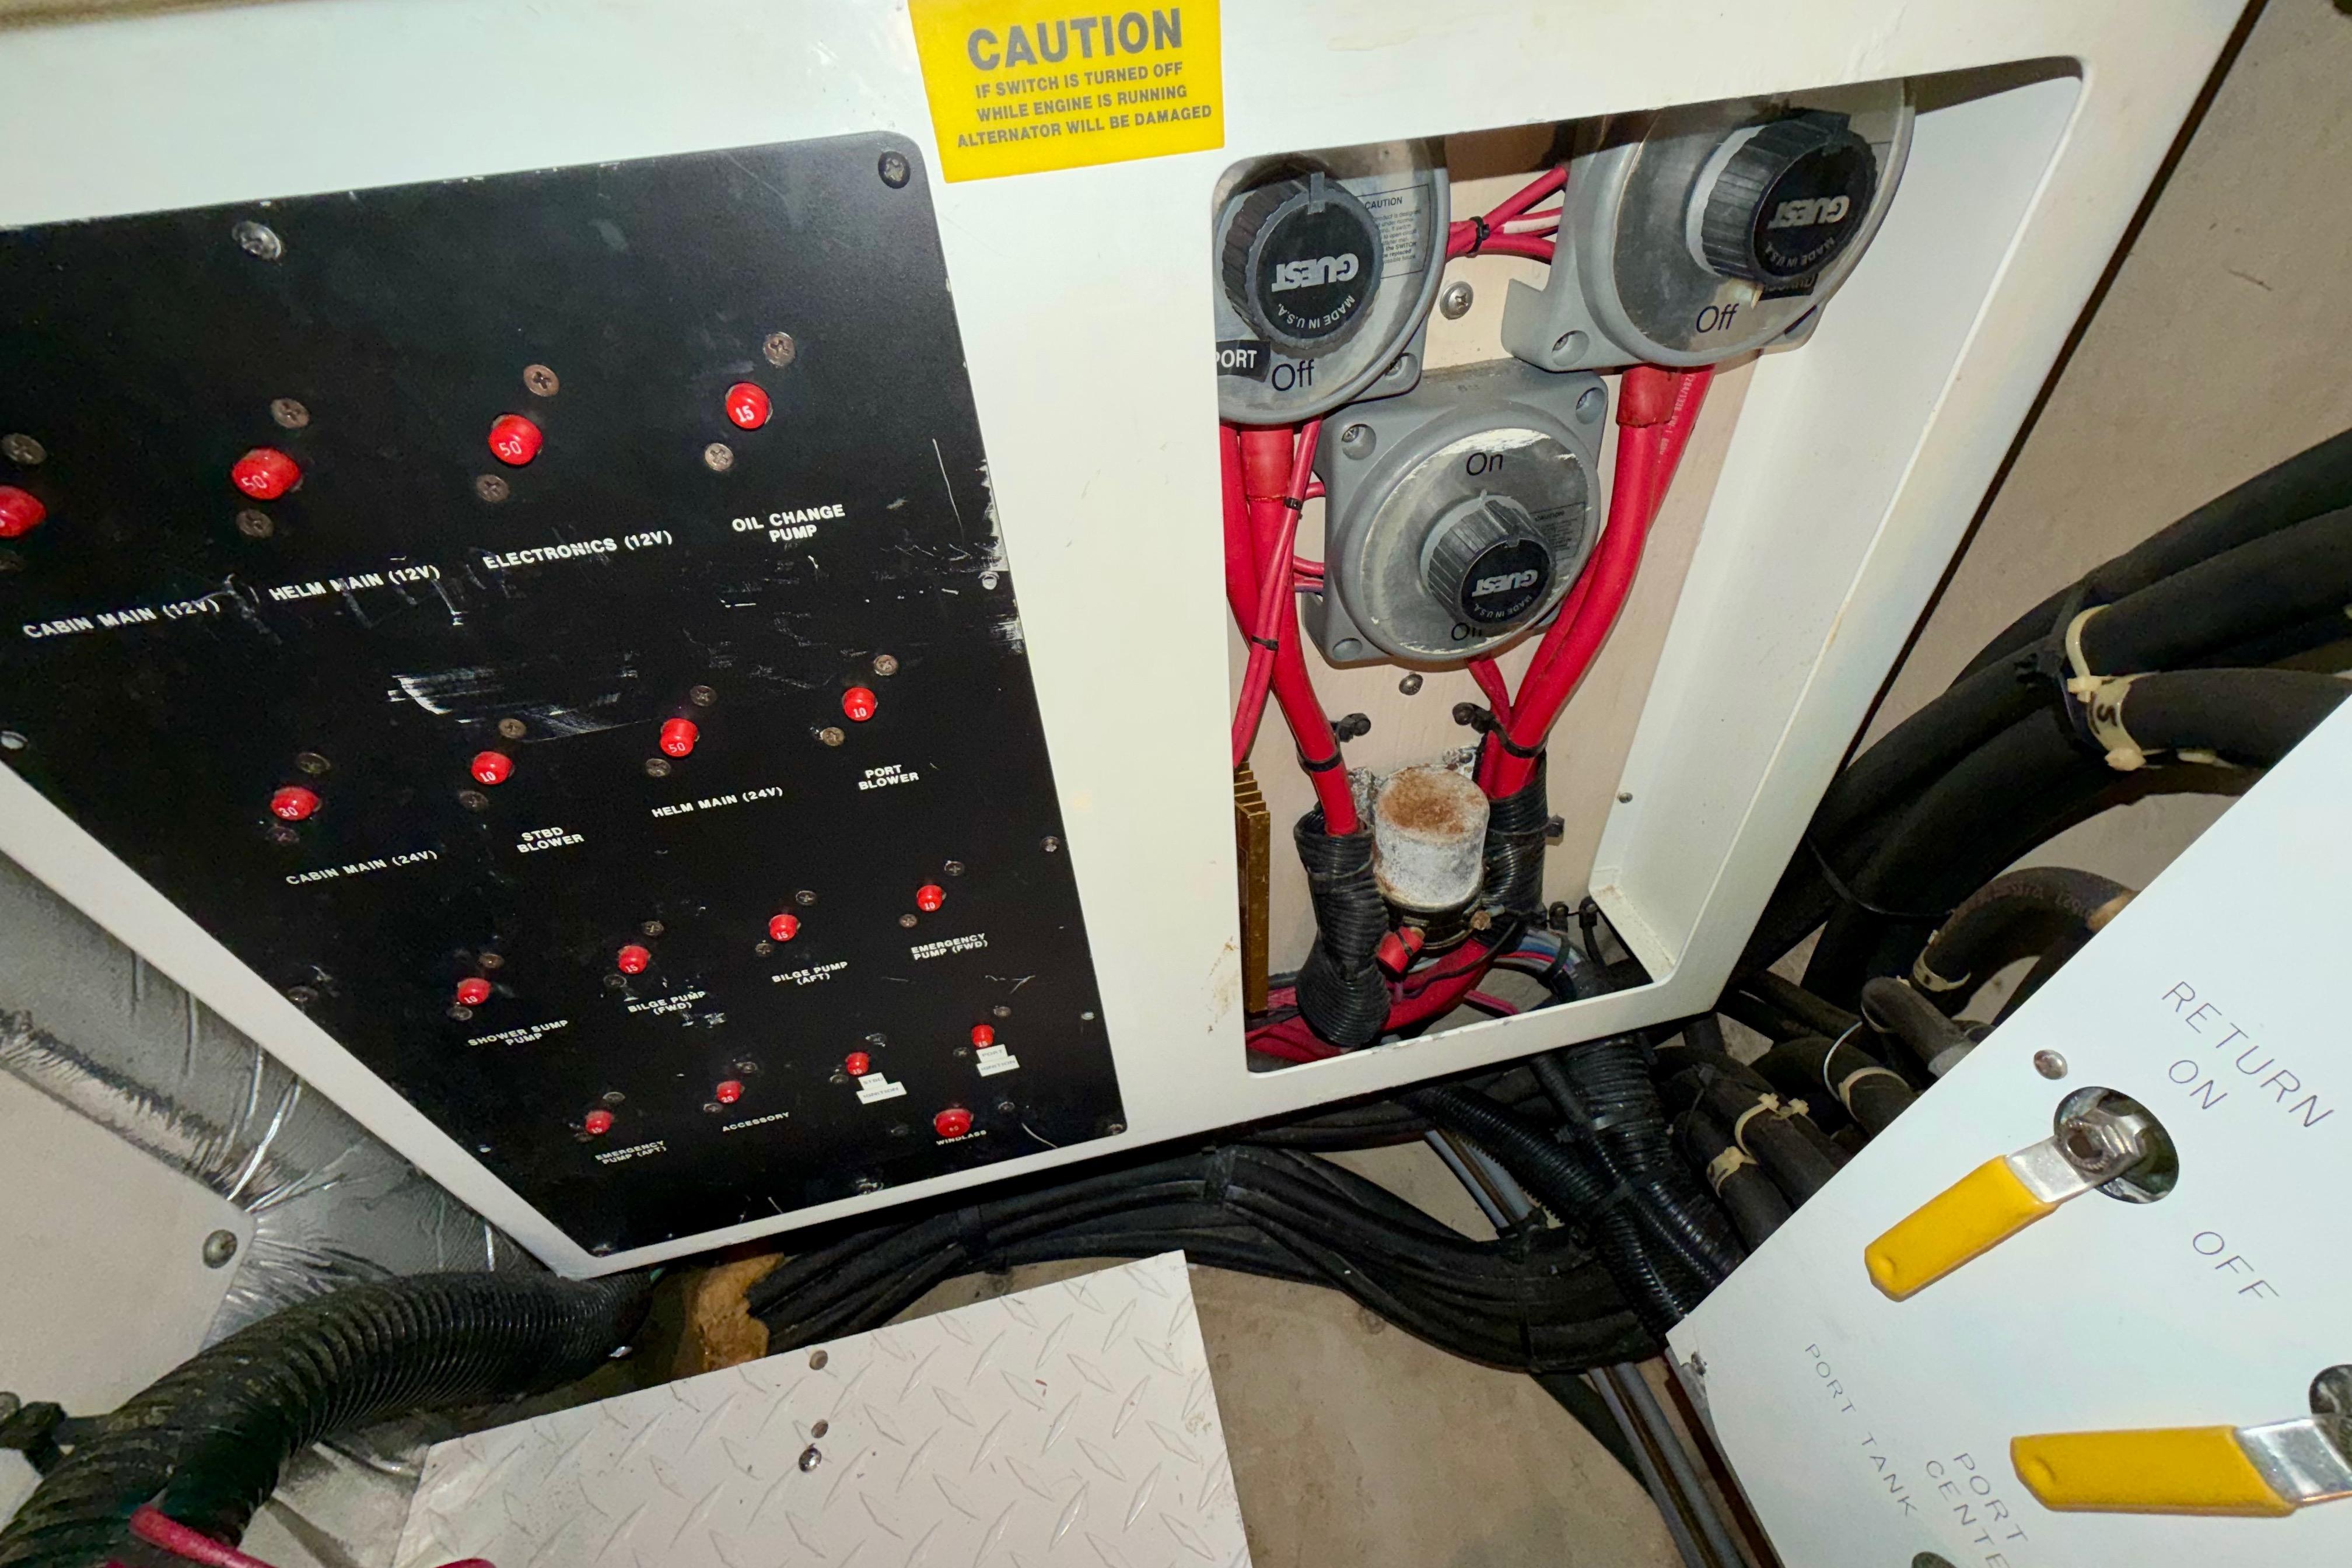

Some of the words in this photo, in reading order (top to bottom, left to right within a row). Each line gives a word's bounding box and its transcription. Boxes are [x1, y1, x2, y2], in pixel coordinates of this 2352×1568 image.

[968, 8, 1182, 71] CAUTION
[975, 84, 991, 99] IF
[996, 76, 1059, 97] SWITCH
[1065, 74, 1079, 89] IS
[1084, 65, 1148, 86] TURNED
[1153, 61, 1182, 78] OFF
[977, 103, 1030, 122] WHILE
[1034, 96, 1092, 116] ENGINE
[1098, 93, 1112, 107] IS
[1117, 85, 1186, 106] RUNNING
[958, 124, 1062, 148] ALTERNATOR
[1066, 118, 1104, 134] WILL
[1110, 115, 1129, 129] BE
[1135, 104, 1212, 126] DAMAGED
[1365, 197, 1402, 209] CAUTION
[1768, 195, 1850, 229] GUEST
[1395, 242, 1417, 250] SWITCH
[1272, 253, 1359, 292] GUEST
[1278, 303, 1306, 328] U.S.A.
[1323, 295, 1356, 326] MADE
[1696, 303, 1739, 333] Off
[1309, 318, 1320, 329] IN
[1272, 359, 1314, 391] Off
[736, 405, 755, 422] 15
[499, 440, 522, 457] 50
[1466, 452, 1504, 476] On
[242, 474, 268, 491] 50
[732, 517, 765, 533] OIL
[768, 504, 845, 527] CHANGE
[768, 524, 818, 543] PUMP
[482, 537, 618, 570] ELECTRONICS
[624, 529, 673, 552] (12V)
[269, 580, 326, 601] HELM
[329, 572, 384, 593] MAIN
[388, 564, 441, 584] (12V)
[1472, 569, 1538, 597] GUEST
[23, 617, 93, 639] CABIN
[99, 607, 156, 628] MAIN
[163, 598, 221, 620] (12V)
[852, 706, 867, 718] 10
[668, 741, 686, 754] 50
[480, 771, 496, 783] 10
[858, 771, 919, 791] BLOWER
[864, 764, 902, 778] PORT
[279, 806, 299, 818] 30
[652, 802, 694, 817] HELM
[698, 794, 737, 810] MAIN
[743, 786, 784, 803] (24V)
[516, 834, 584, 854] BLOWER
[521, 826, 564, 842] STBD
[286, 867, 340, 886] CABIN
[342, 858, 388, 876] MAIN
[391, 849, 438, 867] (24V)
[924, 901, 936, 911] 10
[776, 931, 789, 940] 15
[911, 933, 986, 956] EMERGENCY
[913, 947, 948, 961] PUMP
[952, 939, 989, 954] (FWD)
[625, 963, 639, 974] 15
[772, 970, 810, 984] BILGE
[814, 961, 848, 976] PUMP
[796, 971, 831, 986] (AFT)
[464, 995, 478, 1005] 10
[627, 1000, 666, 1014] BILGE
[668, 991, 706, 1007] PUMP
[653, 1001, 692, 1016] (FWD)
[467, 1028, 527, 1047] SHOWER
[530, 1020, 568, 1035] SUMP
[505, 1032, 542, 1047] PUMP
[981, 1059, 1016, 1071] IGNITION
[2162, 981, 2333, 1128] RETURN
[863, 1087, 899, 1098] IGNITION
[2169, 1059, 2228, 1110] ON
[722, 1111, 790, 1132] ACCESSORY
[936, 1129, 987, 1146] WINDLASS
[595, 1140, 664, 1161] EMERGENCY
[602, 1153, 632, 1165] PUMP
[637, 1146, 667, 1157] (AFT)
[2193, 1231, 2279, 1298] OFF
[1805, 1343, 1856, 1414] PORT
[1861, 1432, 1917, 1517] TANK
[1954, 1452, 2028, 1542] PORT
